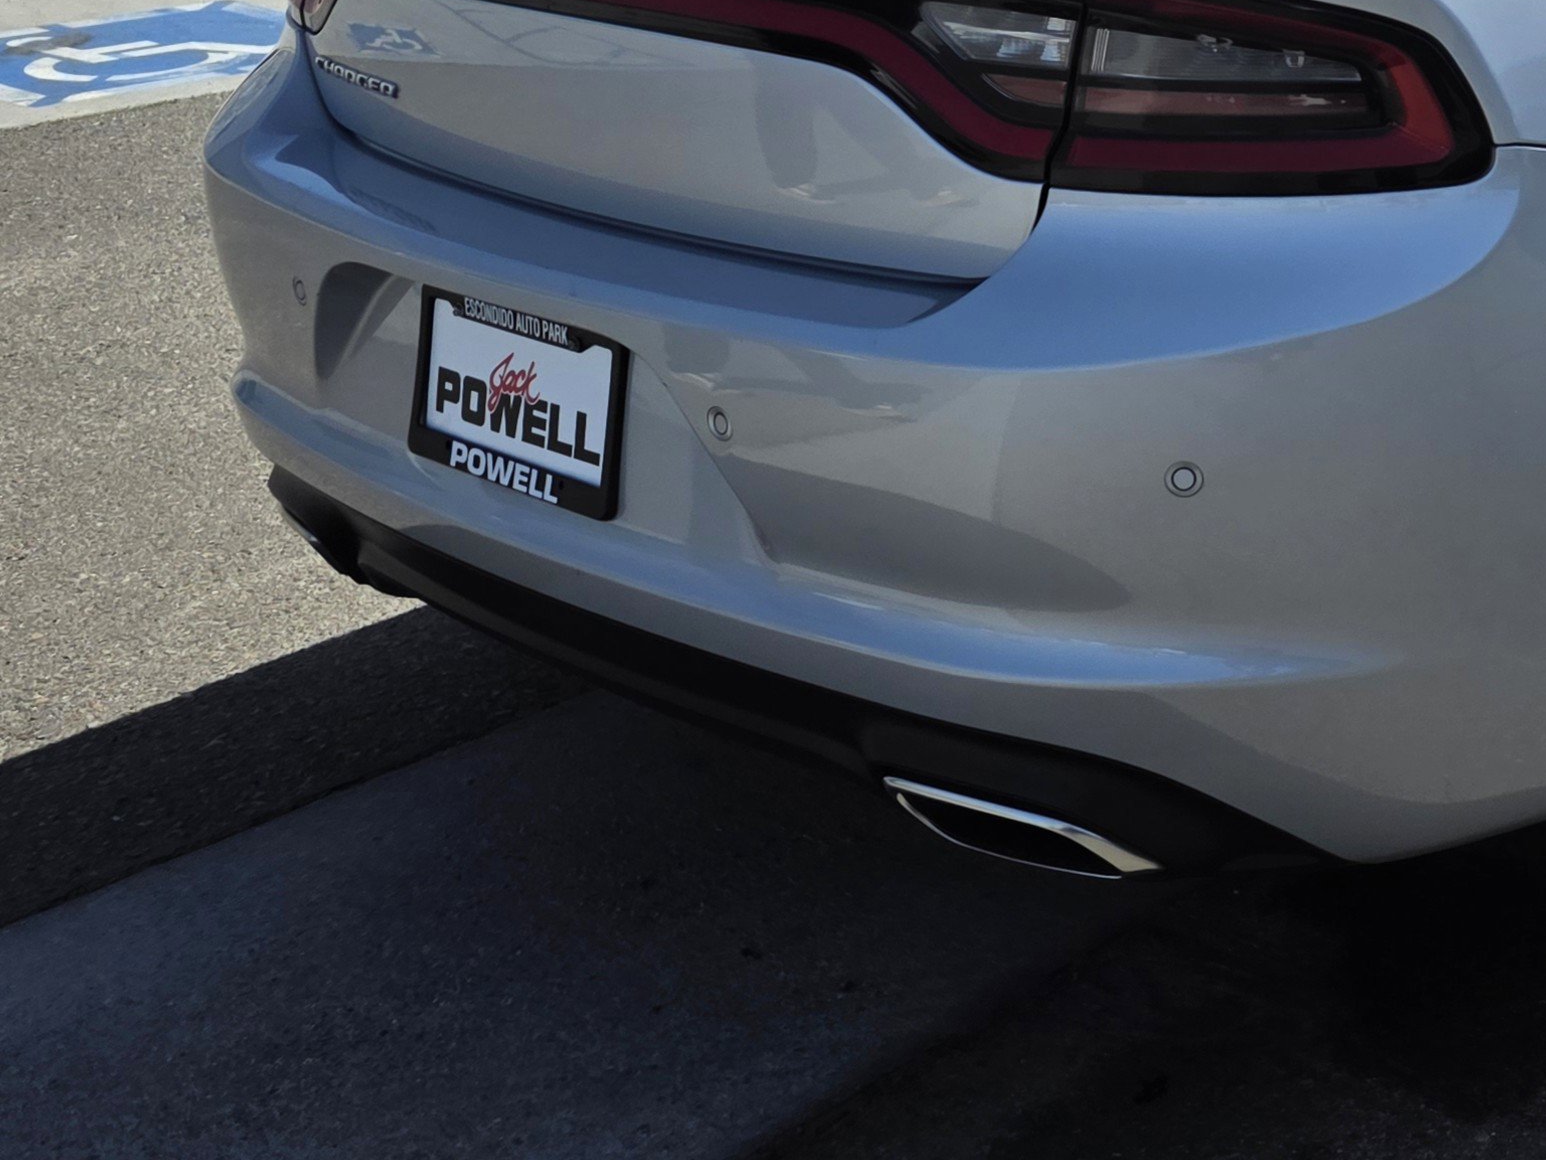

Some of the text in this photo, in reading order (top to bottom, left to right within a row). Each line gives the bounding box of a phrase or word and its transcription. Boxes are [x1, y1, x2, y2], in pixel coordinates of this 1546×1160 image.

[464, 297, 569, 346] ESCONDIDO AUTO PARK
[487, 352, 540, 413] Jack
[436, 366, 600, 467] POWELL
[450, 441, 559, 504] POWELL
